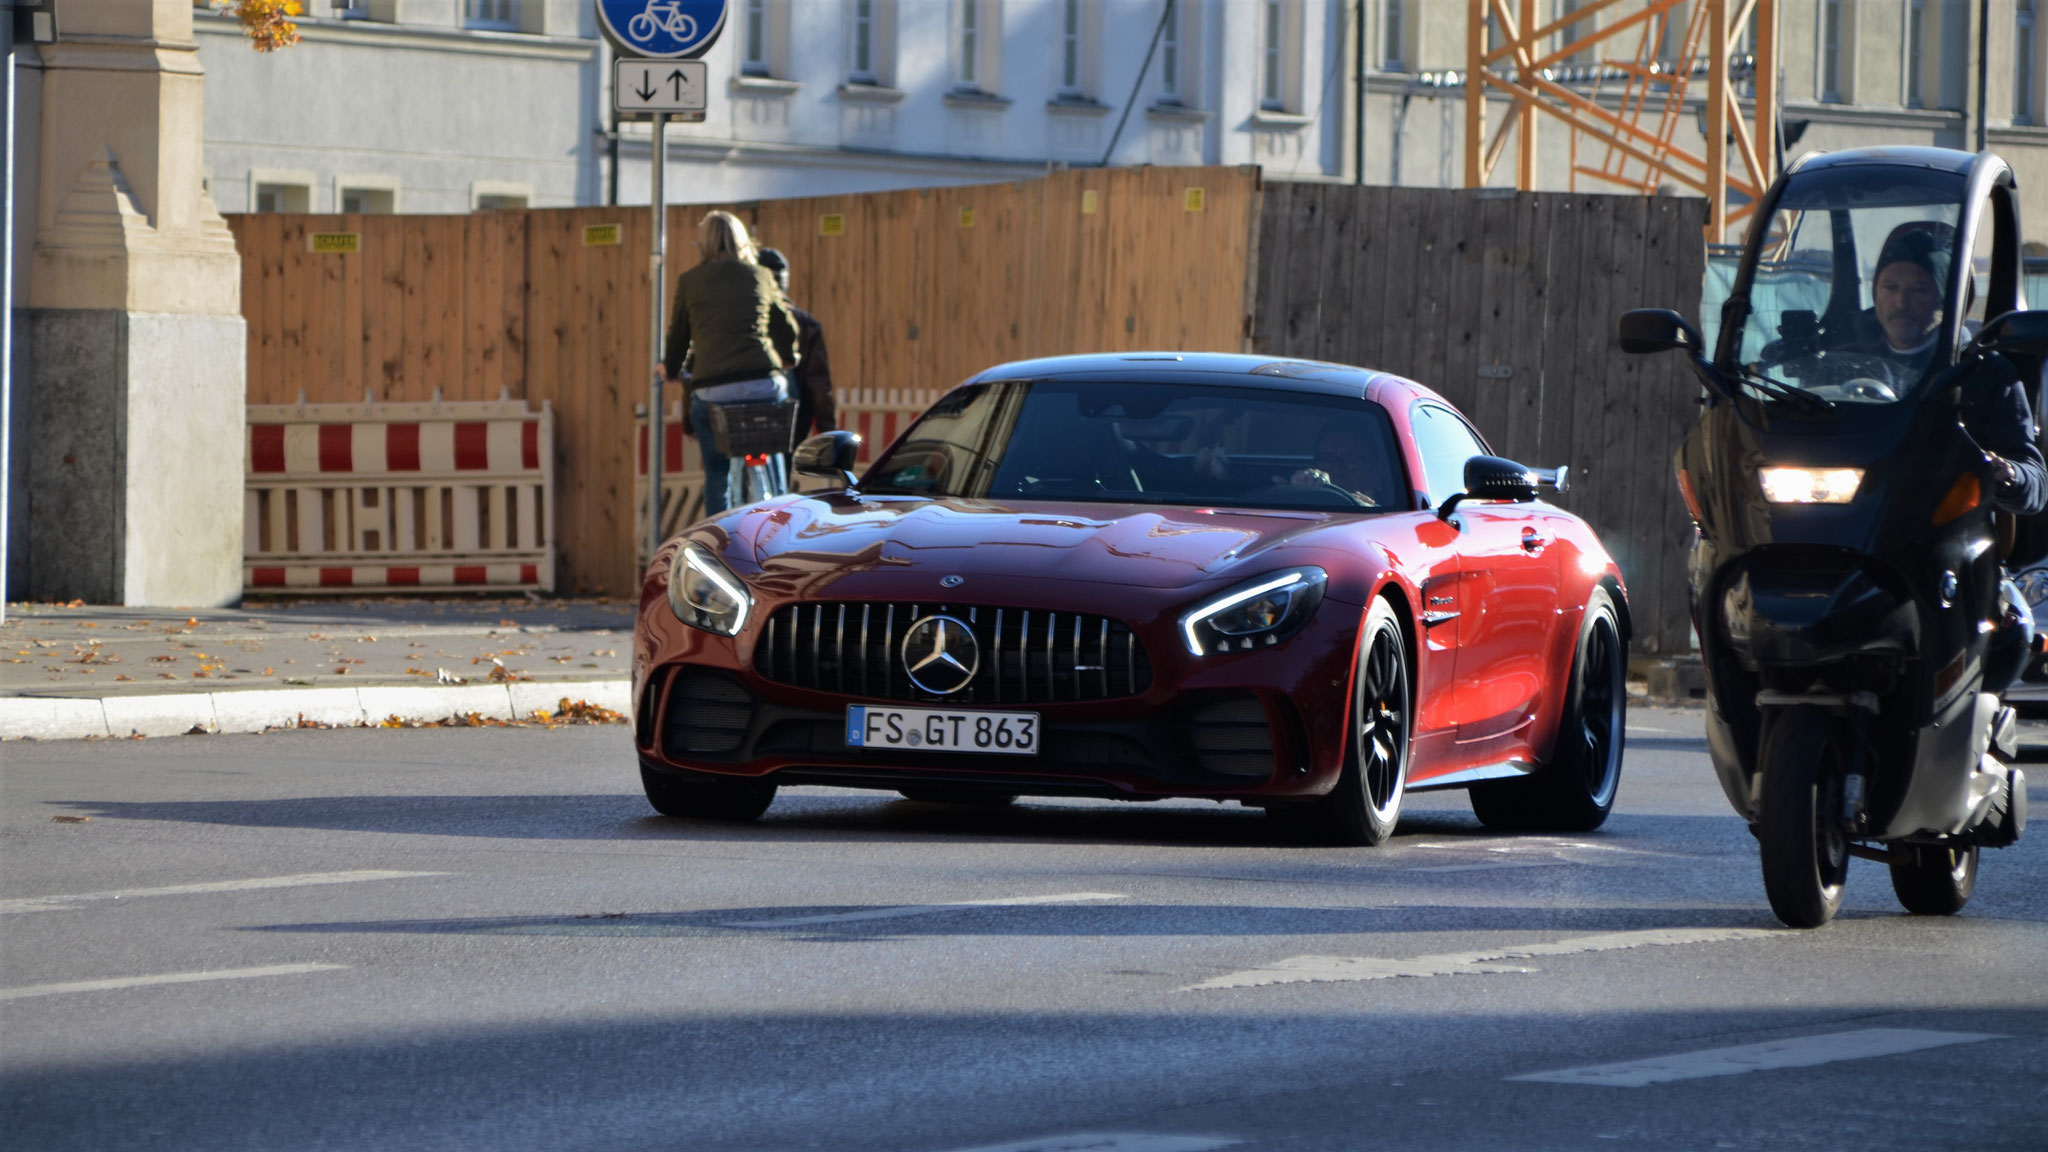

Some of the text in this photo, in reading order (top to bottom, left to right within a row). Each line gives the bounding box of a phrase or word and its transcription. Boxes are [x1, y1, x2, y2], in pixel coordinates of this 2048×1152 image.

[852, 729, 860, 739] D
[865, 712, 1034, 749] FS GT 863
